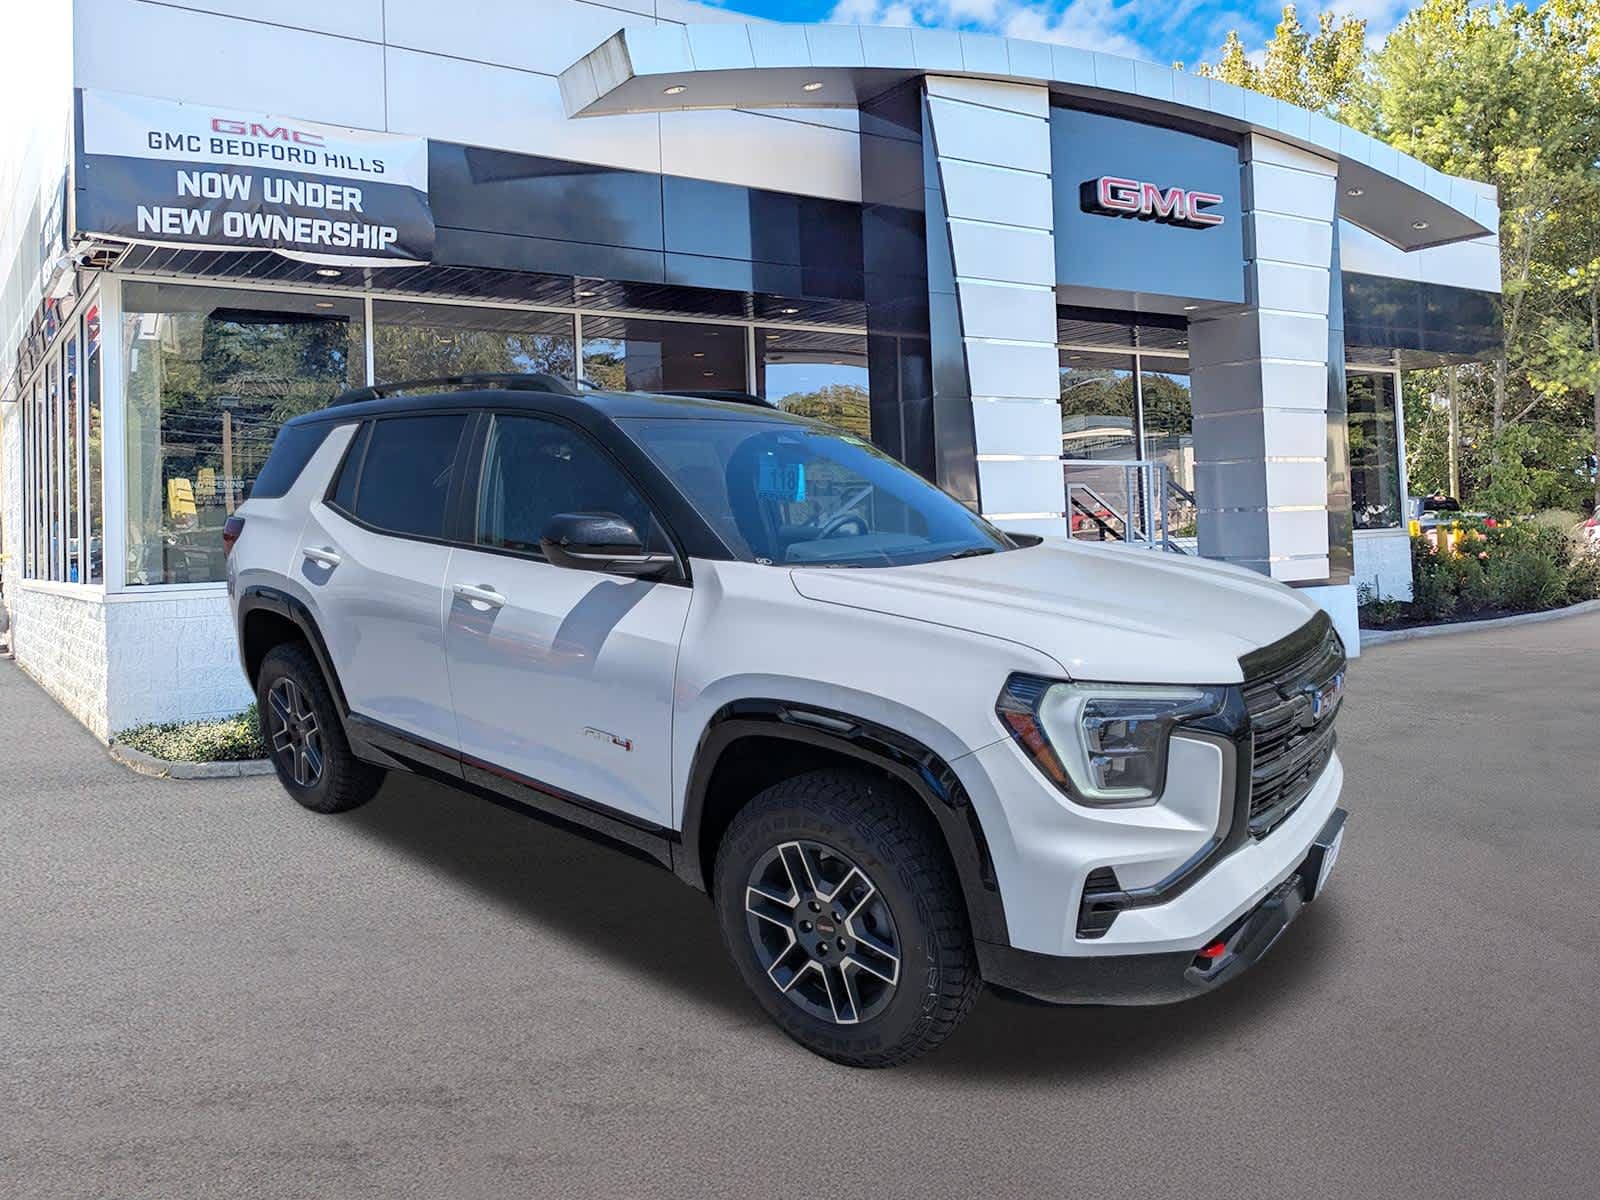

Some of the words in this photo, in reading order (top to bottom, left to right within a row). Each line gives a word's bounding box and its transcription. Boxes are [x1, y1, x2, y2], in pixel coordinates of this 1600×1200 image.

[148, 131, 200, 152] GMC
[211, 139, 316, 165] BEDFORD
[325, 154, 385, 174] HILLS
[211, 118, 326, 147] GMC
[177, 170, 251, 201] NOW
[263, 177, 364, 213] UNDER
[1096, 176, 1224, 225] GMC
[136, 205, 212, 236] NEW
[223, 211, 398, 250] OWNERSHIP
